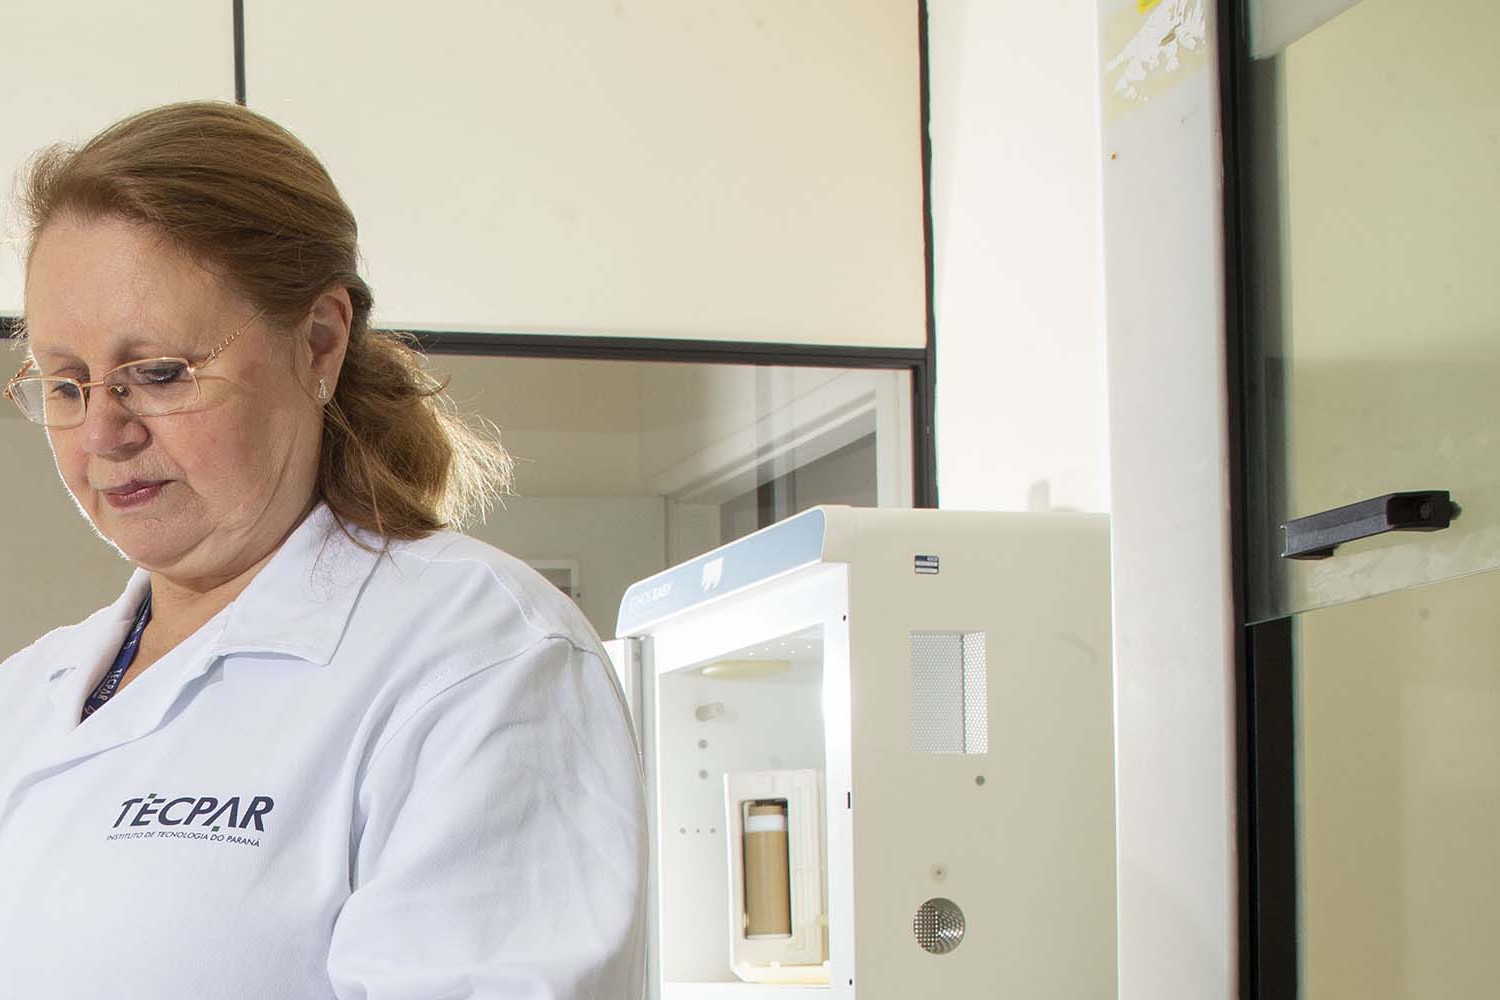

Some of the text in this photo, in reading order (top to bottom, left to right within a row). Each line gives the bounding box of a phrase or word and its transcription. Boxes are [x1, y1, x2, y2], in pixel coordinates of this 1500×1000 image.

[106, 831, 261, 848] INSTITUTO DE TECNOLOGIA DO PARANÁ
